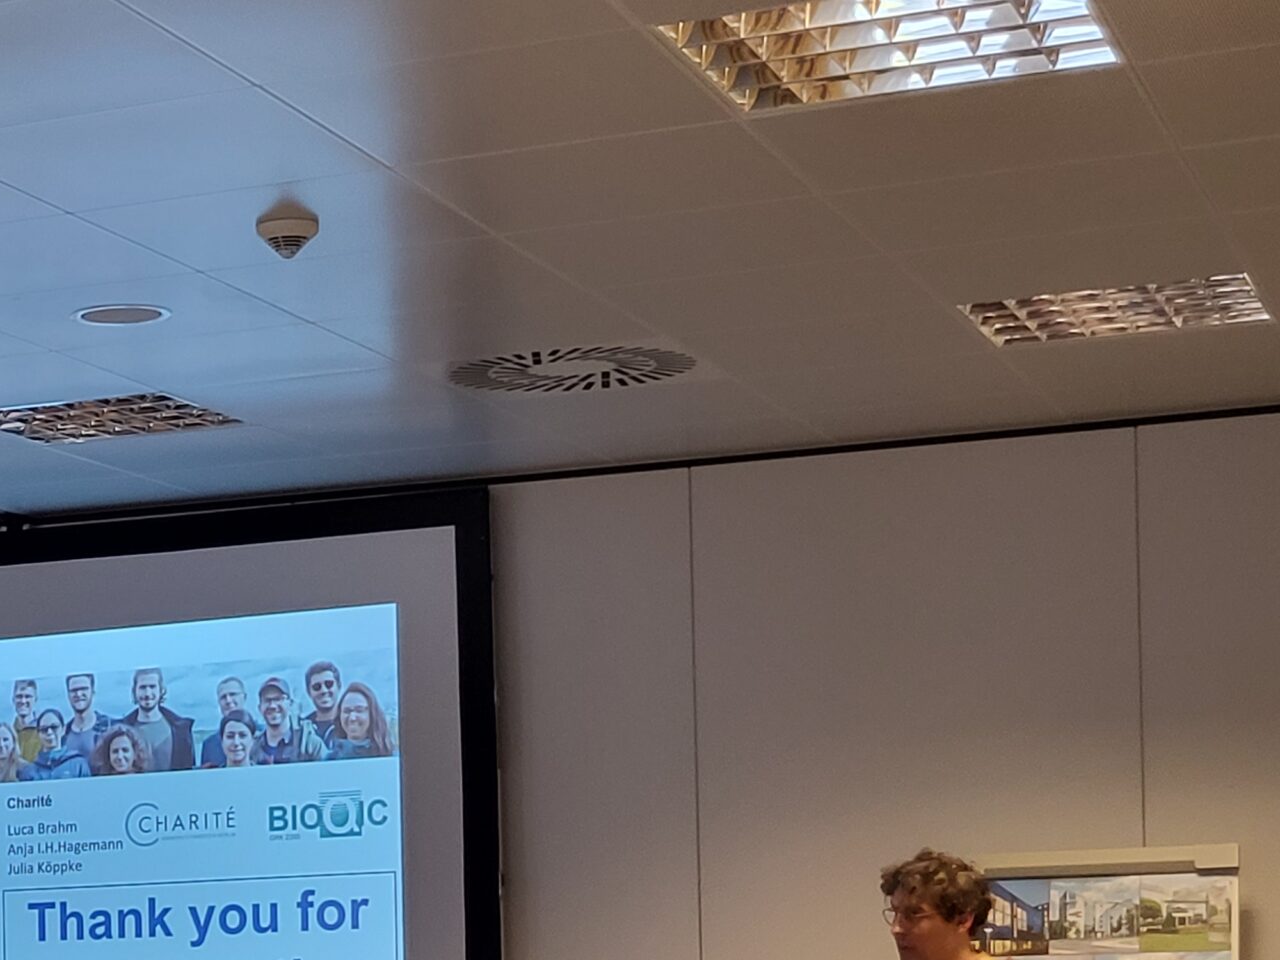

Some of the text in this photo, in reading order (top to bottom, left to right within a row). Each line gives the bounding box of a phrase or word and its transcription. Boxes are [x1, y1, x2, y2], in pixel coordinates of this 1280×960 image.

[7, 794, 53, 809] Charité
[138, 805, 237, 834] CHARITÉ
[7, 821, 77, 836] Luca Brahm
[7, 842, 34, 858] Anja
[8, 860, 83, 875] Julia Köppke
[27, 889, 370, 948] Thank you for
